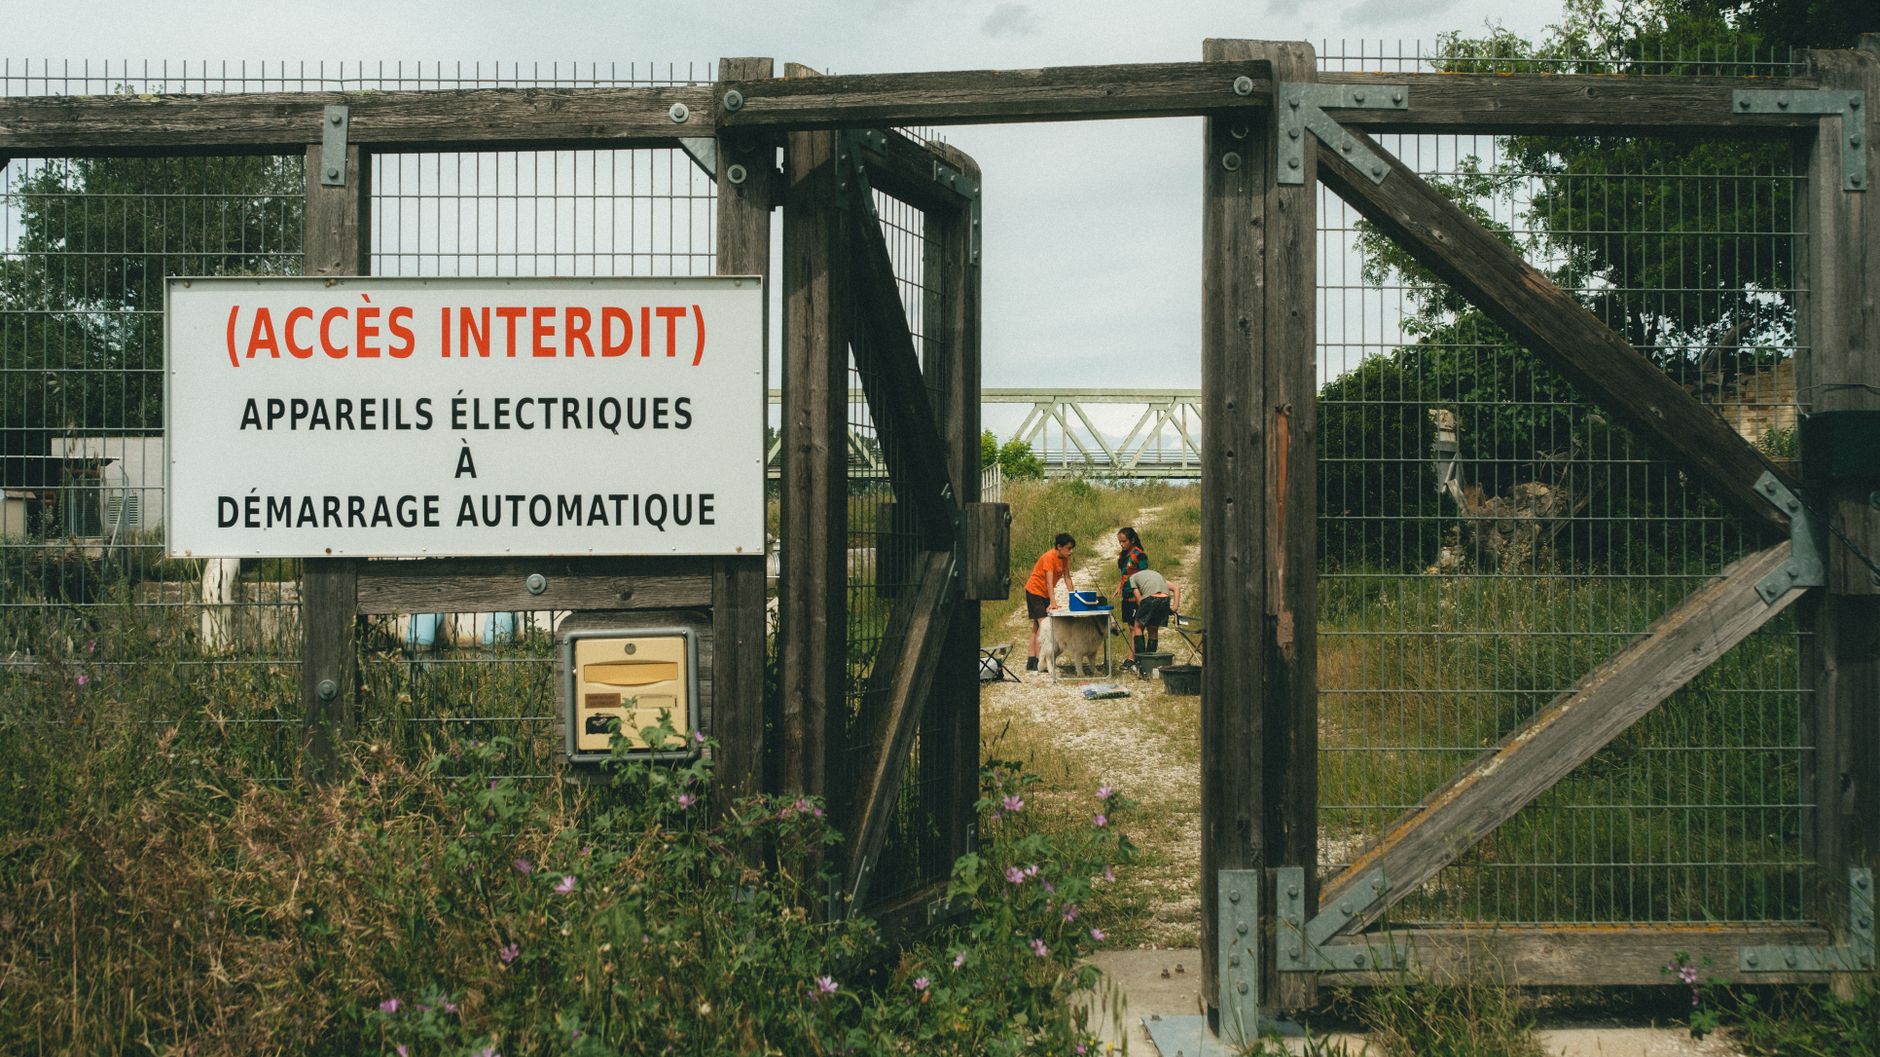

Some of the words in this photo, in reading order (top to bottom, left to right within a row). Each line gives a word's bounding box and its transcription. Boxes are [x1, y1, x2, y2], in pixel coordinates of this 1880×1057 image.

[226, 293, 416, 368] (ACCÈS
[441, 304, 707, 367] INTERDIT)
[239, 397, 434, 431] APPAREILS
[451, 389, 693, 435] ÉLECTRIQUES
[454, 438, 477, 479] À
[217, 488, 440, 529] DÉMARRAGE
[455, 493, 716, 532] AUTOMATIQUE
